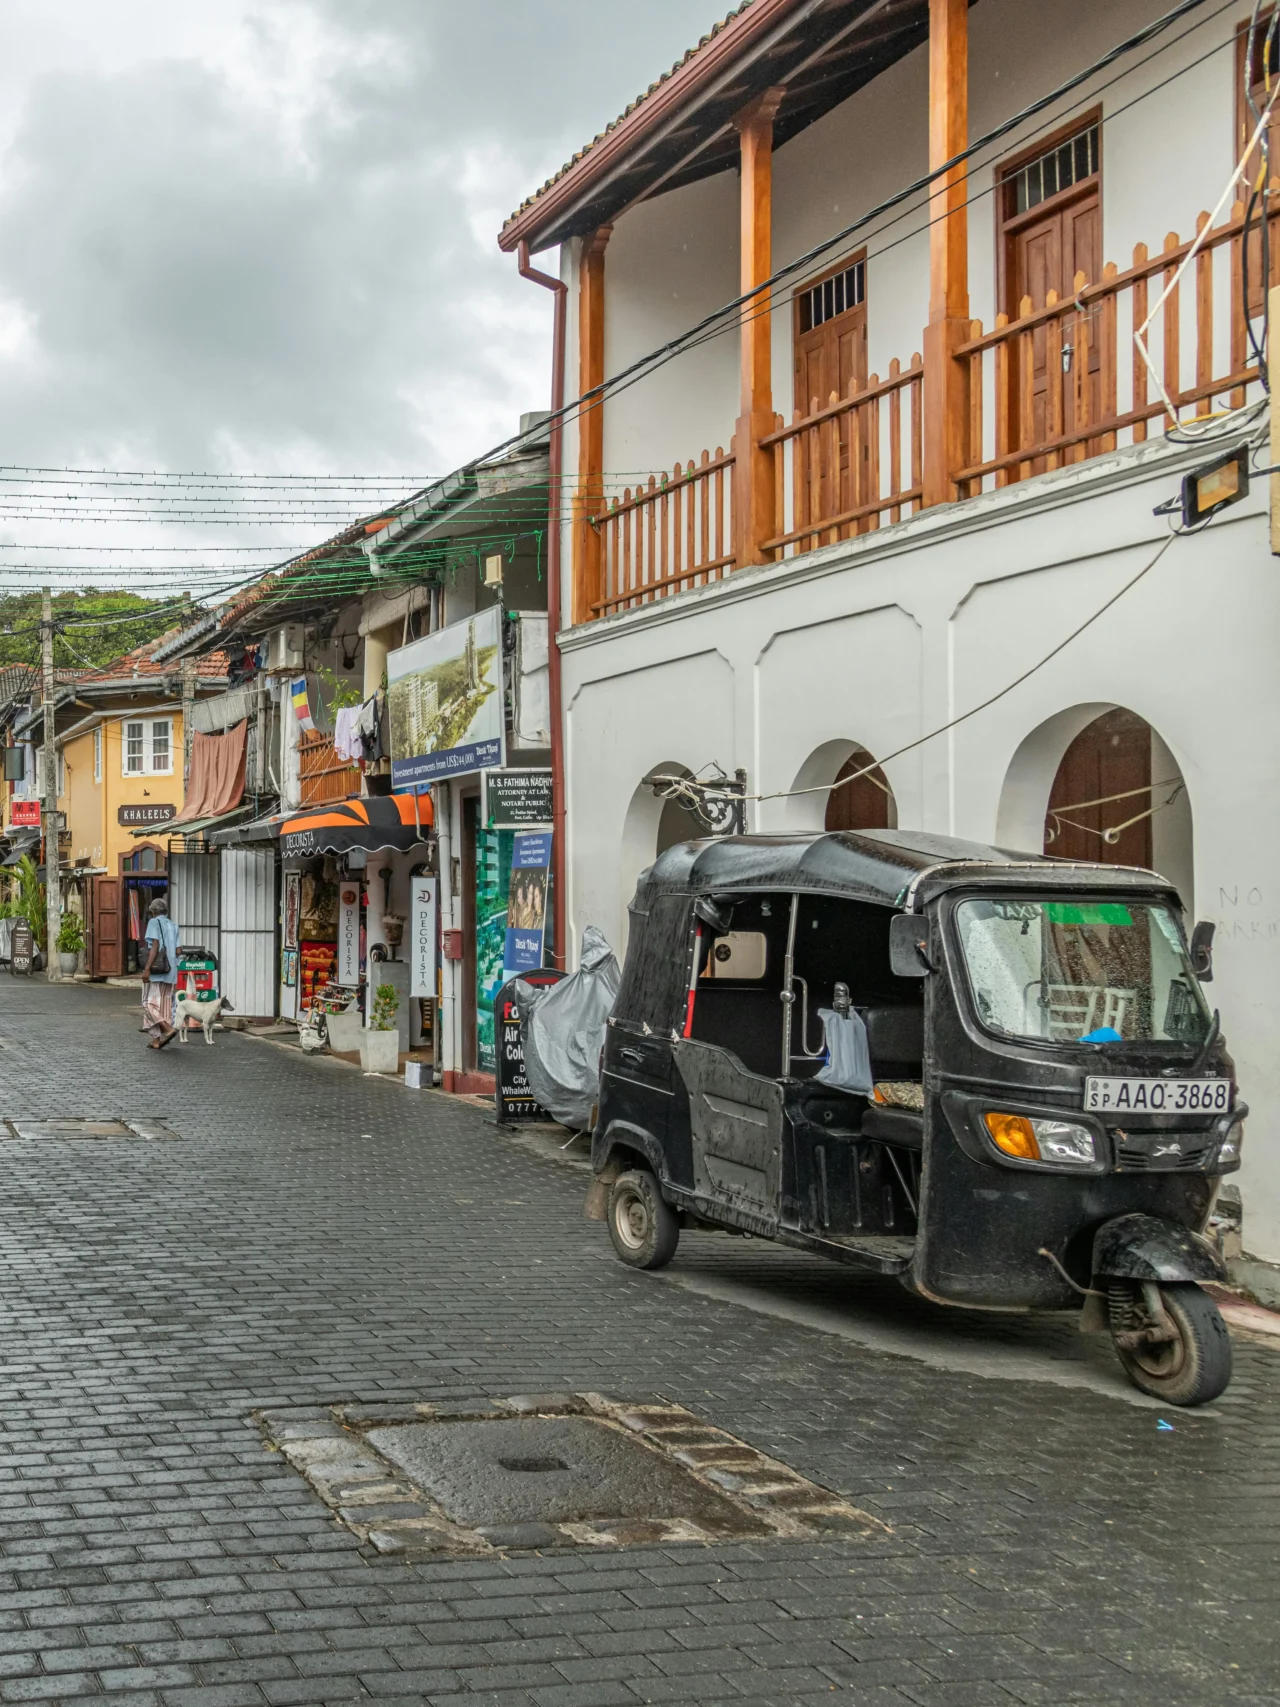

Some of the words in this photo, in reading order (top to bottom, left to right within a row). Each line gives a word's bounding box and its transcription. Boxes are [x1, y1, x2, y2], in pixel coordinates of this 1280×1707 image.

[414, 761, 436, 776] apartments
[435, 758, 447, 770] from
[504, 777, 529, 787] FATHIMA
[286, 831, 314, 849] DECORISTA
[1219, 884, 1262, 909] NO
[345, 910, 353, 977] DECORISTA
[420, 911, 428, 988] DECORISTA
[504, 1027, 518, 1042] Air
[513, 1076, 527, 1086] City
